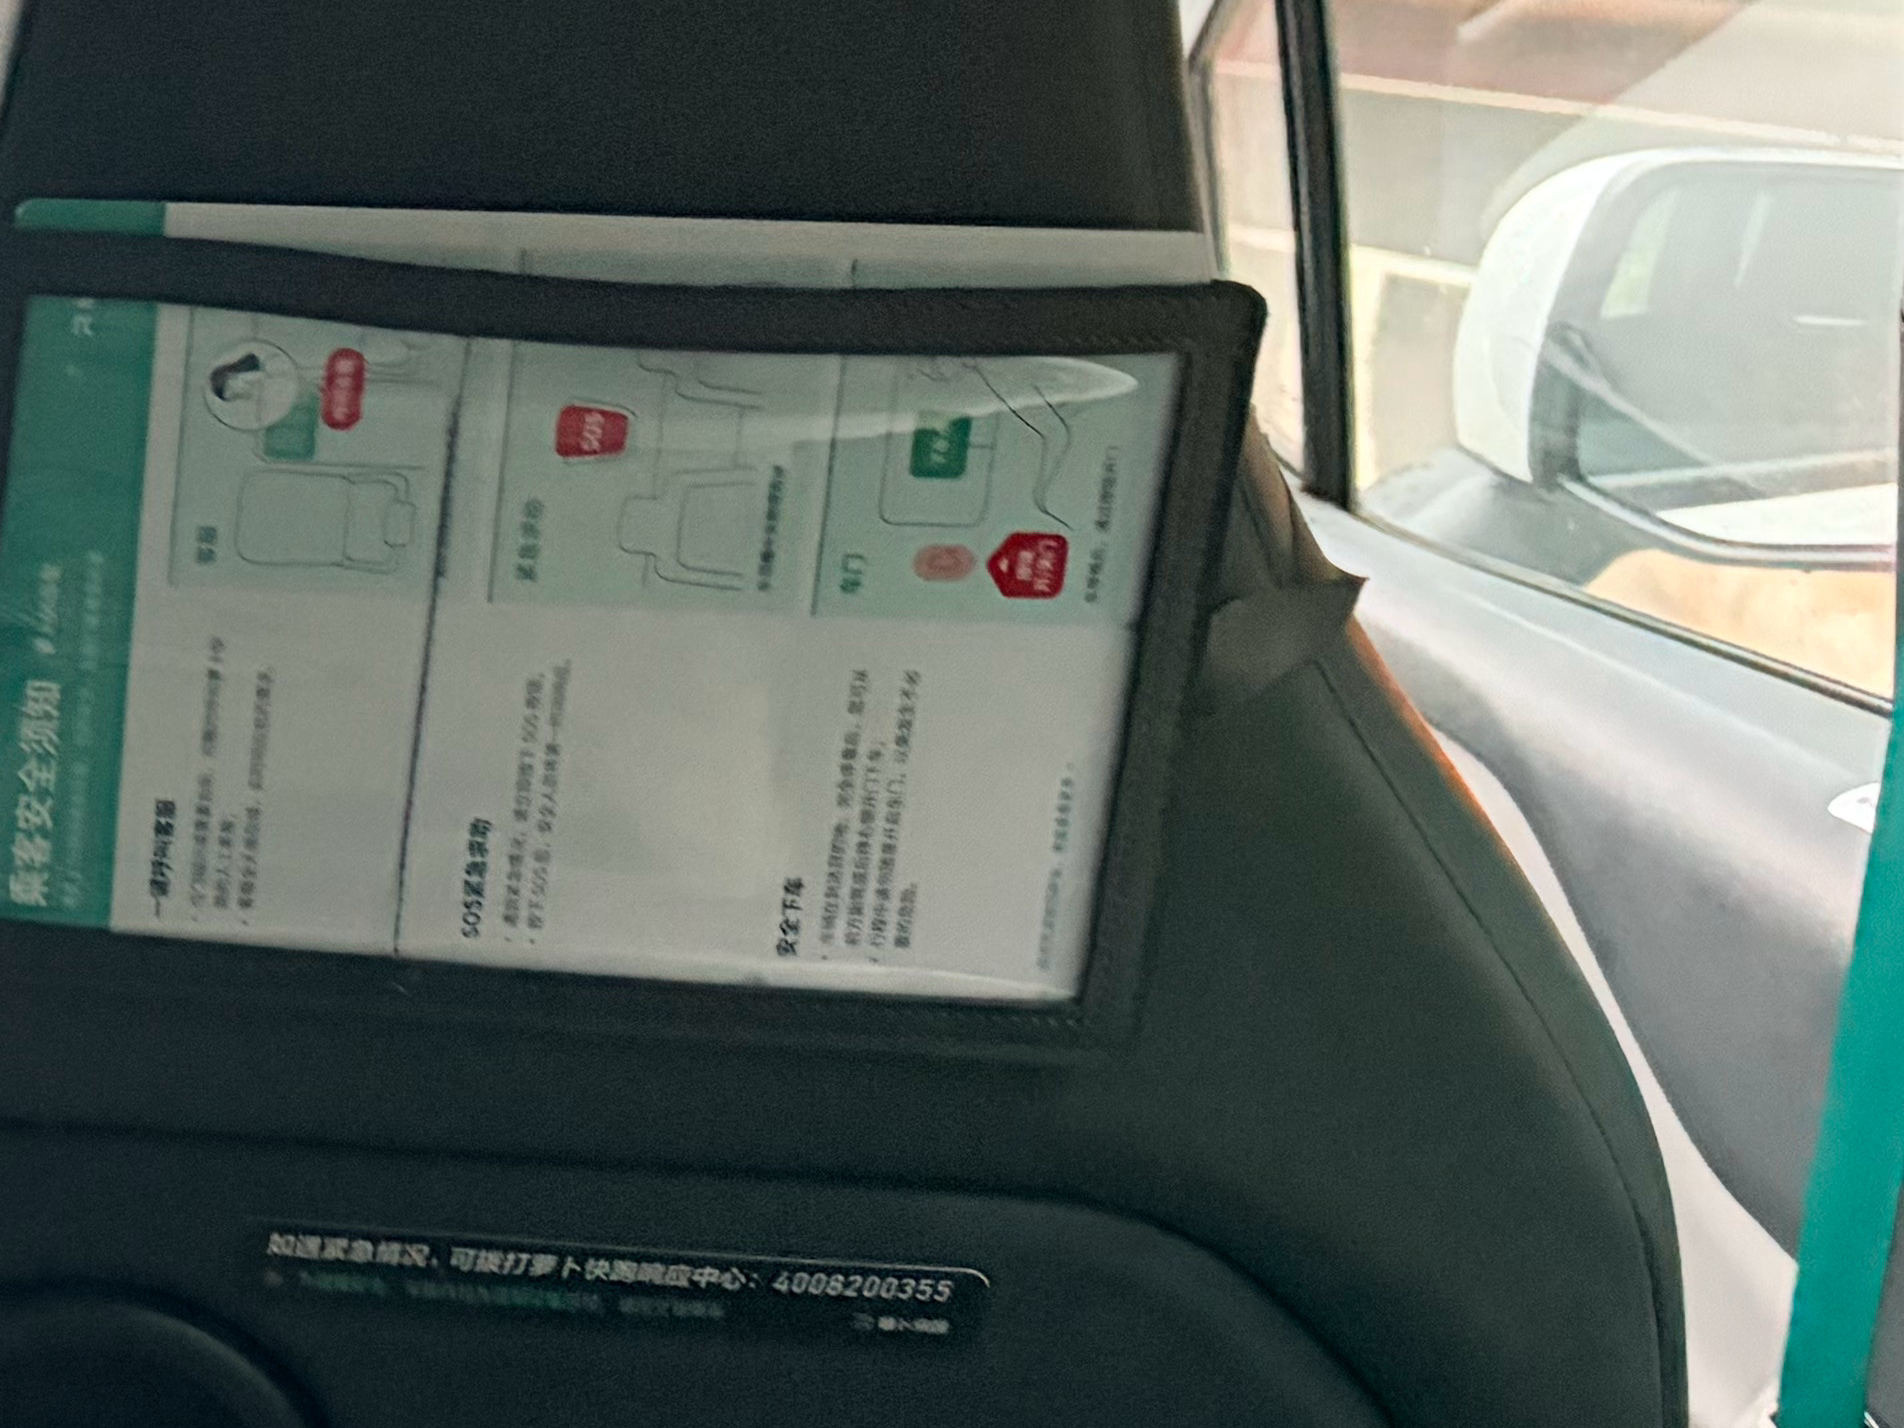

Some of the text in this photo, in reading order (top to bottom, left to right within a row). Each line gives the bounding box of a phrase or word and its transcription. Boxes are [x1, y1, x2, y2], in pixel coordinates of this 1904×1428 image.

[580, 410, 605, 451] SOS
[7, 680, 64, 905] 乘客安全须知
[457, 816, 491, 939] SOS紧急求助
[775, 875, 805, 958] 安全下车
